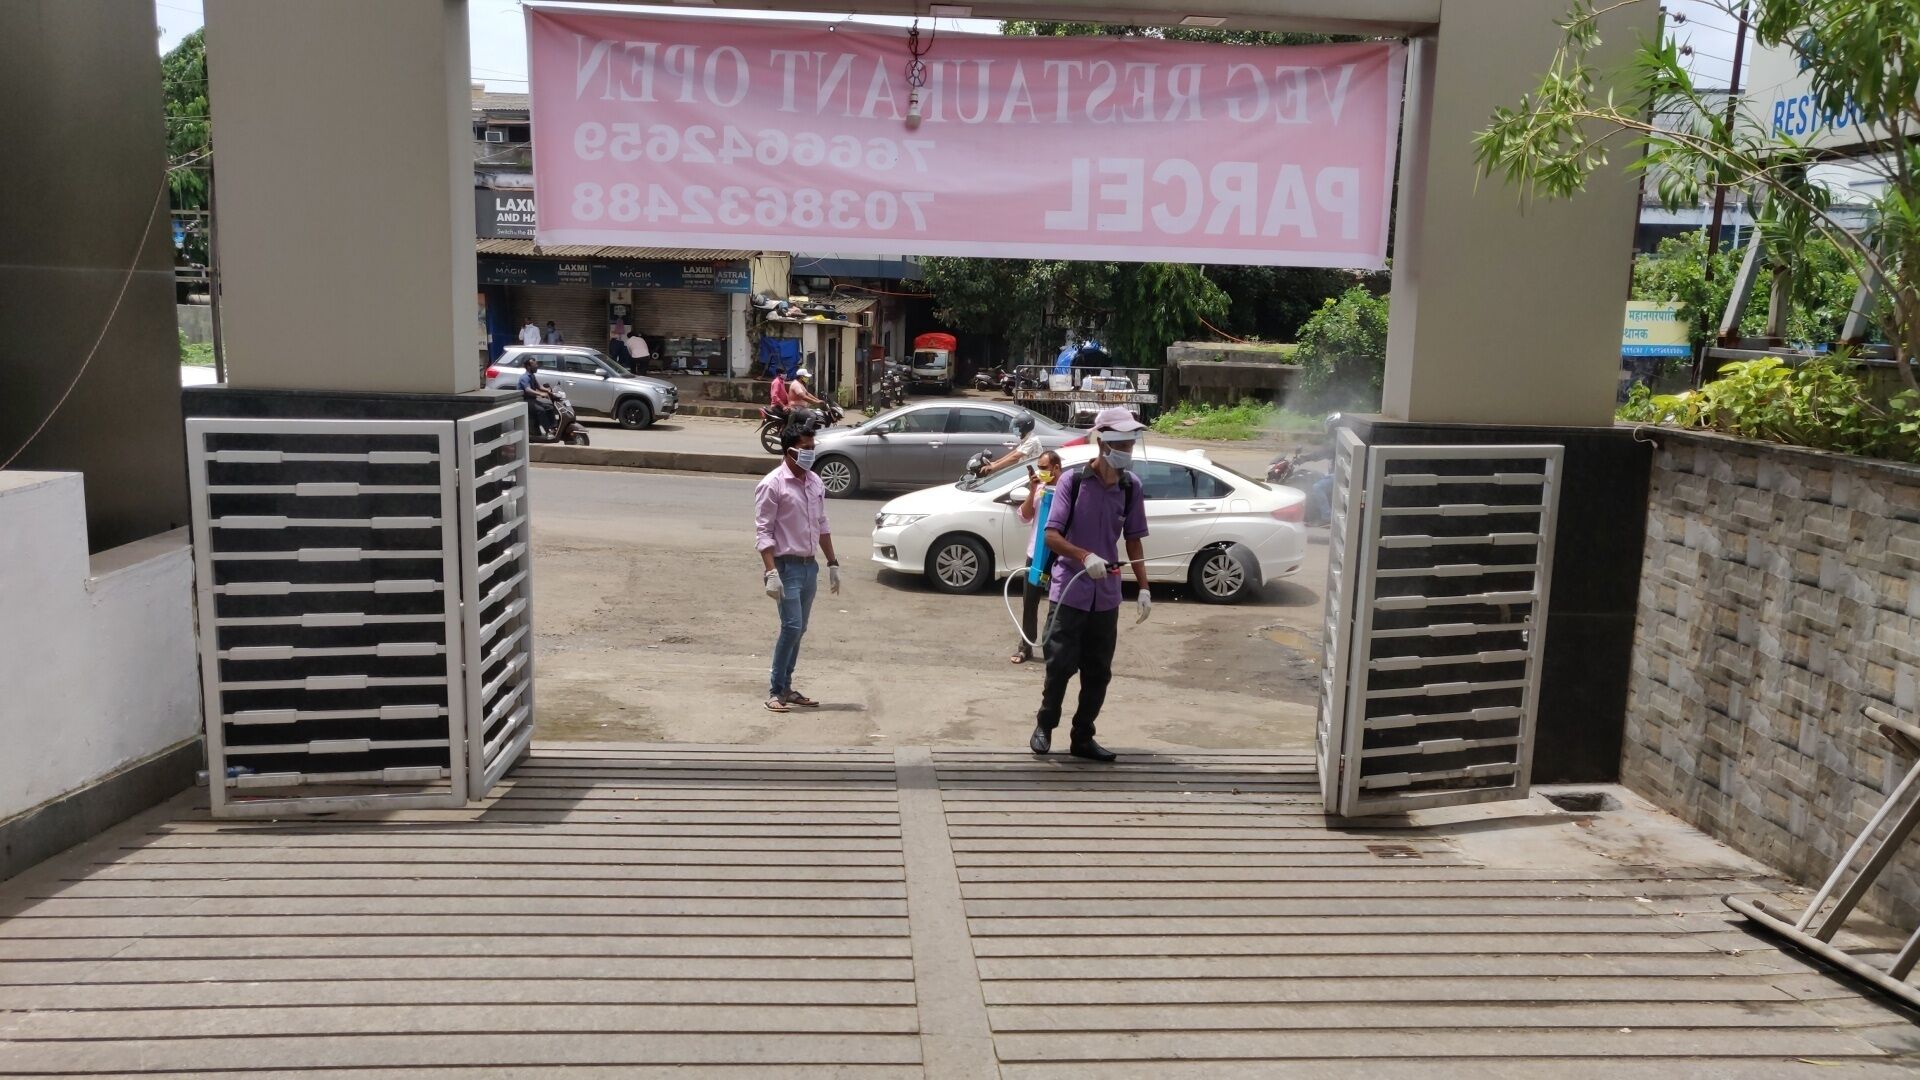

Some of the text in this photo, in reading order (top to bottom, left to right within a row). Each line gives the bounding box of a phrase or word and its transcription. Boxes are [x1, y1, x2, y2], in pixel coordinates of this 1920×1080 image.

[496, 212, 520, 222] AND
[558, 263, 588, 272] LAXMI
[717, 271, 748, 279] ASTRAL
